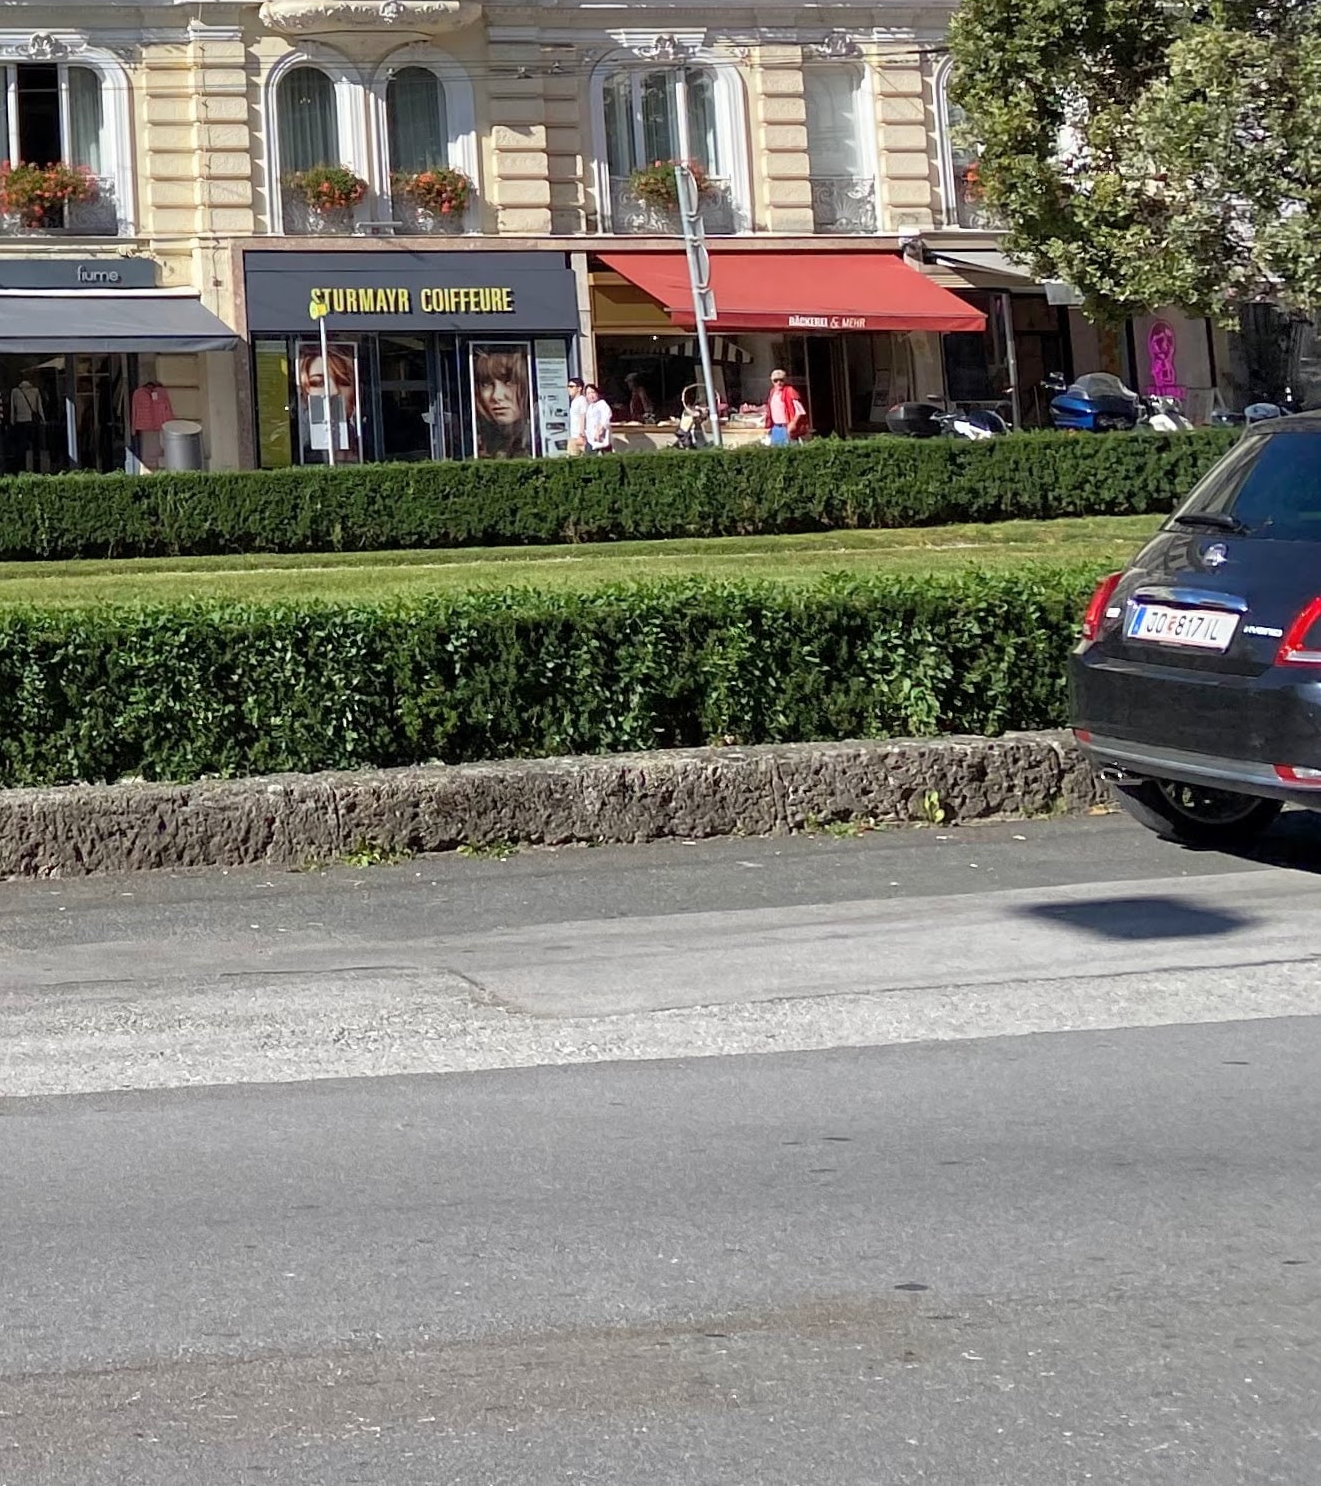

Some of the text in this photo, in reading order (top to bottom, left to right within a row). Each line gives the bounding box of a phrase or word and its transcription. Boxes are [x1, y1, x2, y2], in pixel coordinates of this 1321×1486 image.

[77, 265, 119, 282] fiume
[310, 287, 513, 312] STURMAYR COIFFEURE
[830, 316, 840, 329] &
[841, 317, 866, 329] MEHR
